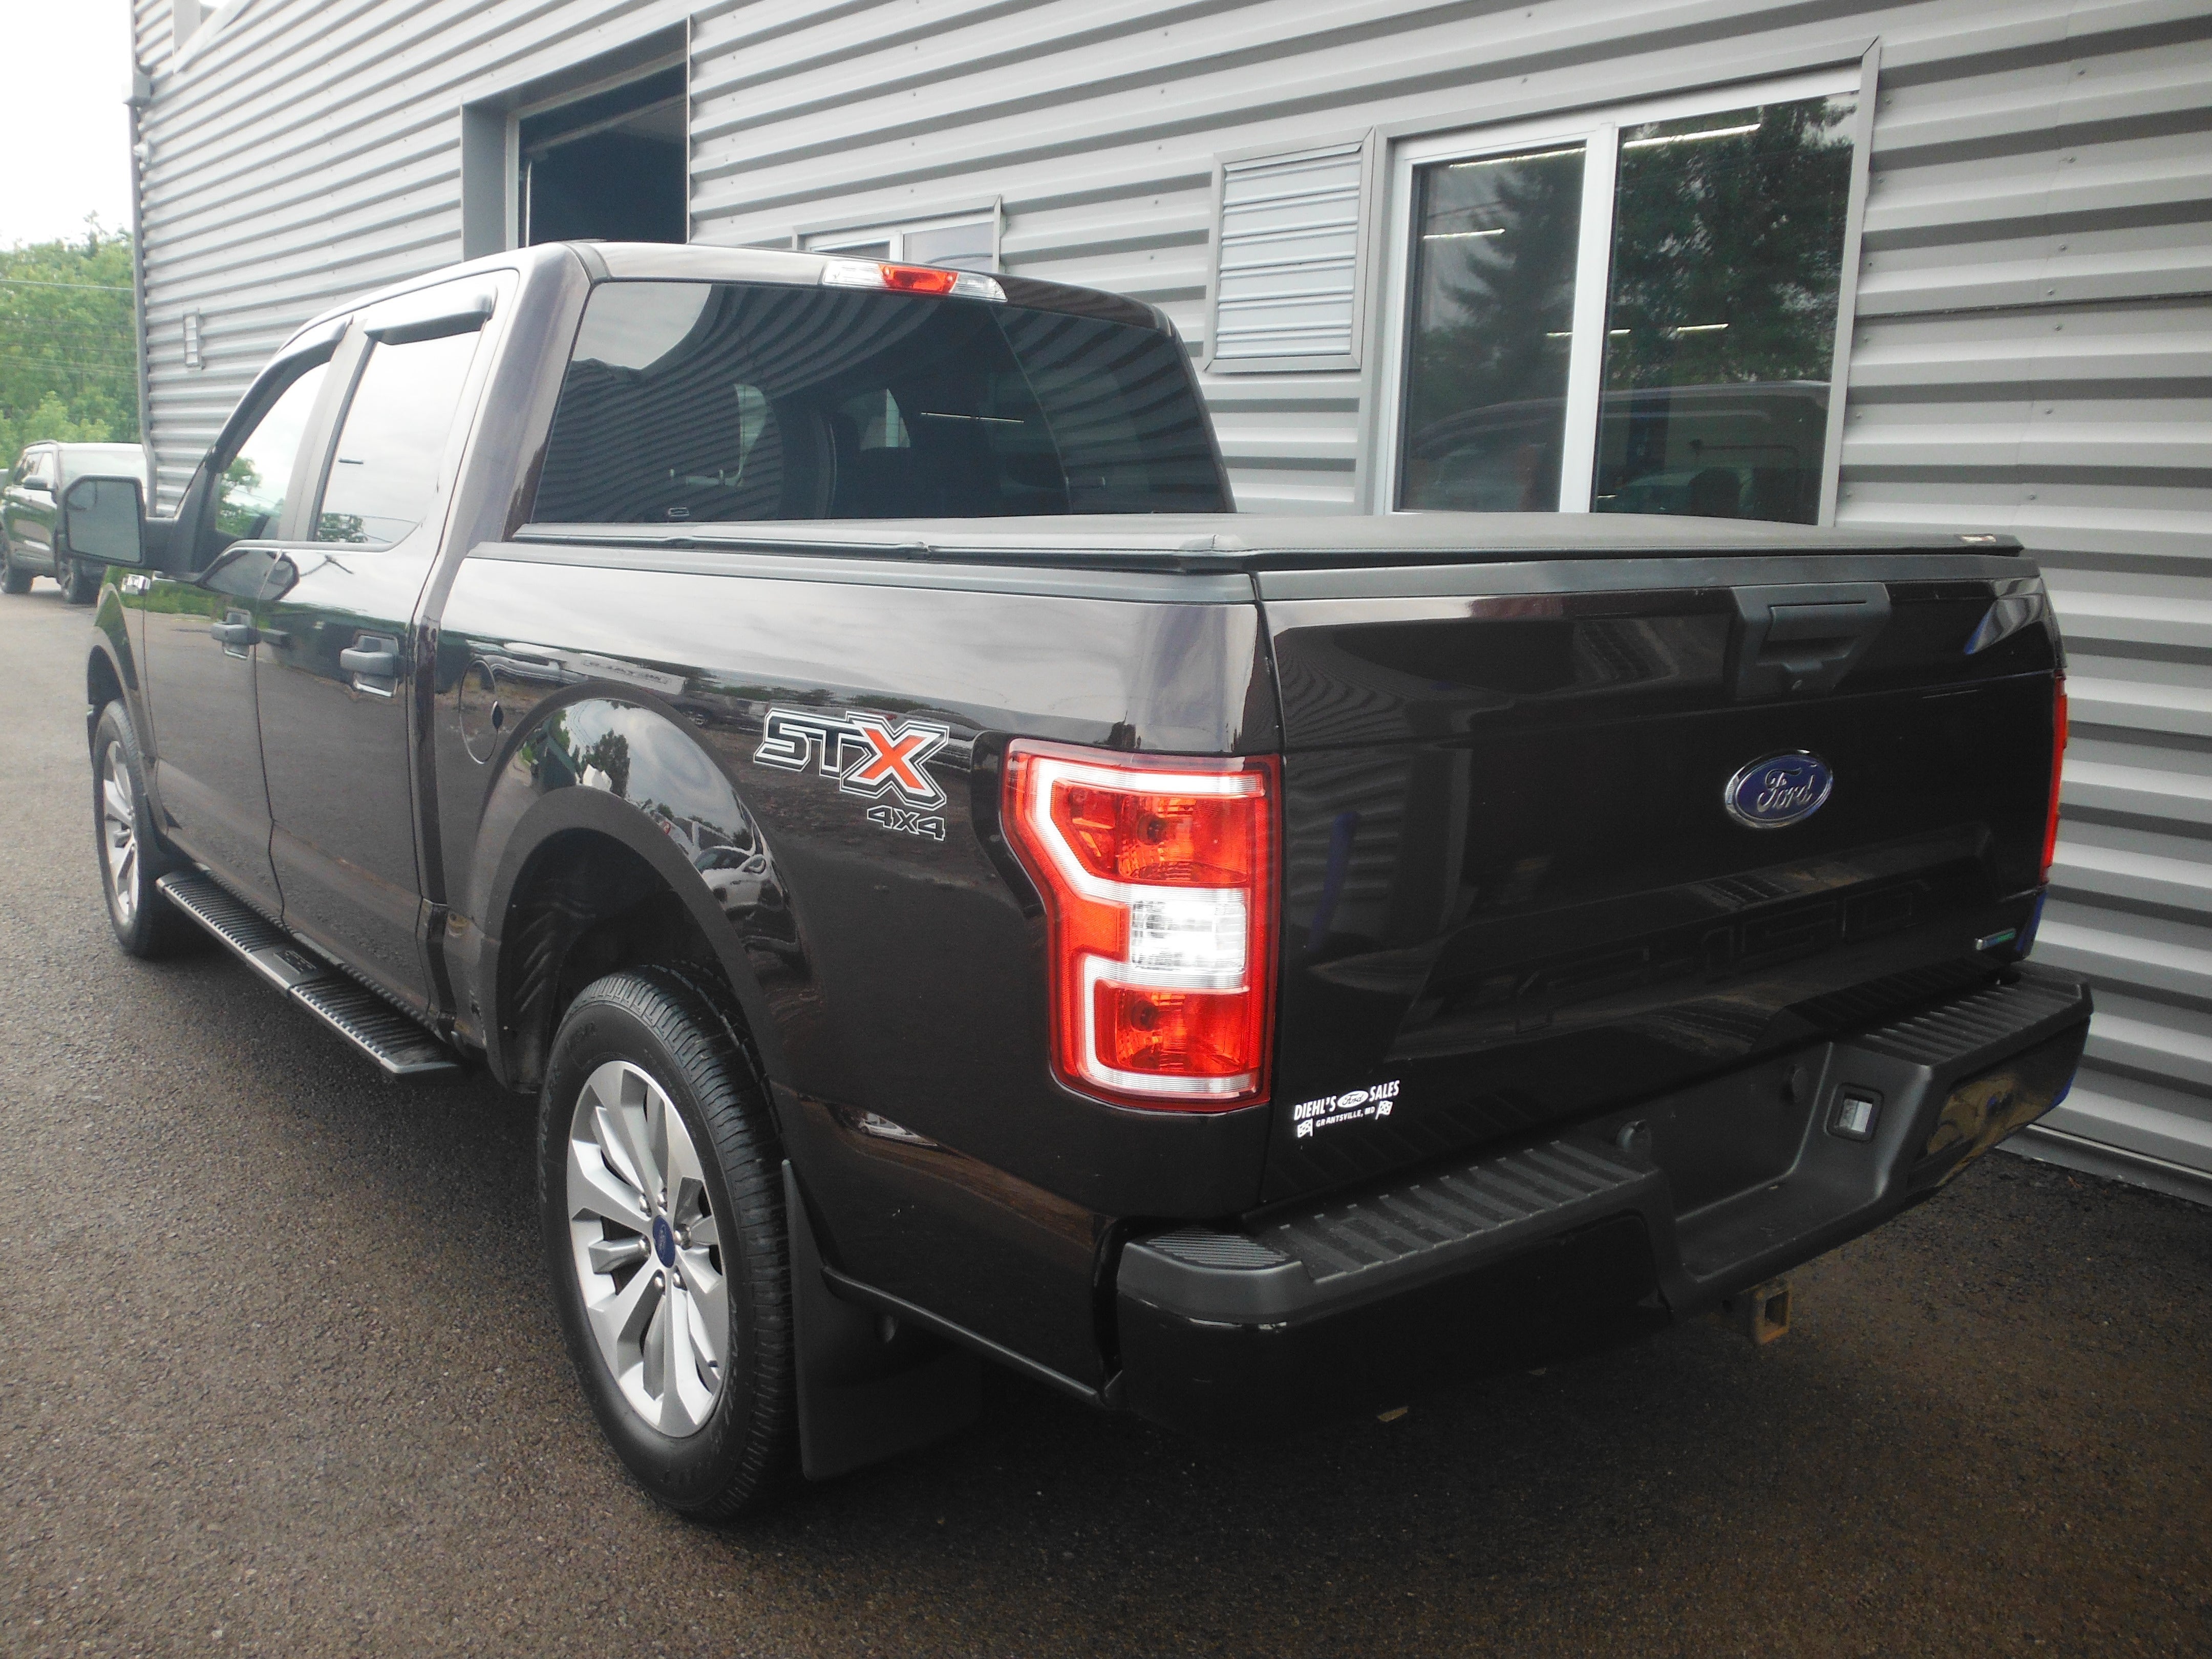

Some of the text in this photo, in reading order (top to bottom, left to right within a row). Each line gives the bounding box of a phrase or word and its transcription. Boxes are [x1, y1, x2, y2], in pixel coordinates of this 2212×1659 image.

[753, 708, 950, 811] STX
[1757, 767, 1816, 812] Ford
[1293, 1095, 1337, 1120] DIEHL'S
[1369, 1079, 1400, 1102] SALES
[1315, 1106, 1376, 1128] GRANTSVILLE, MD
